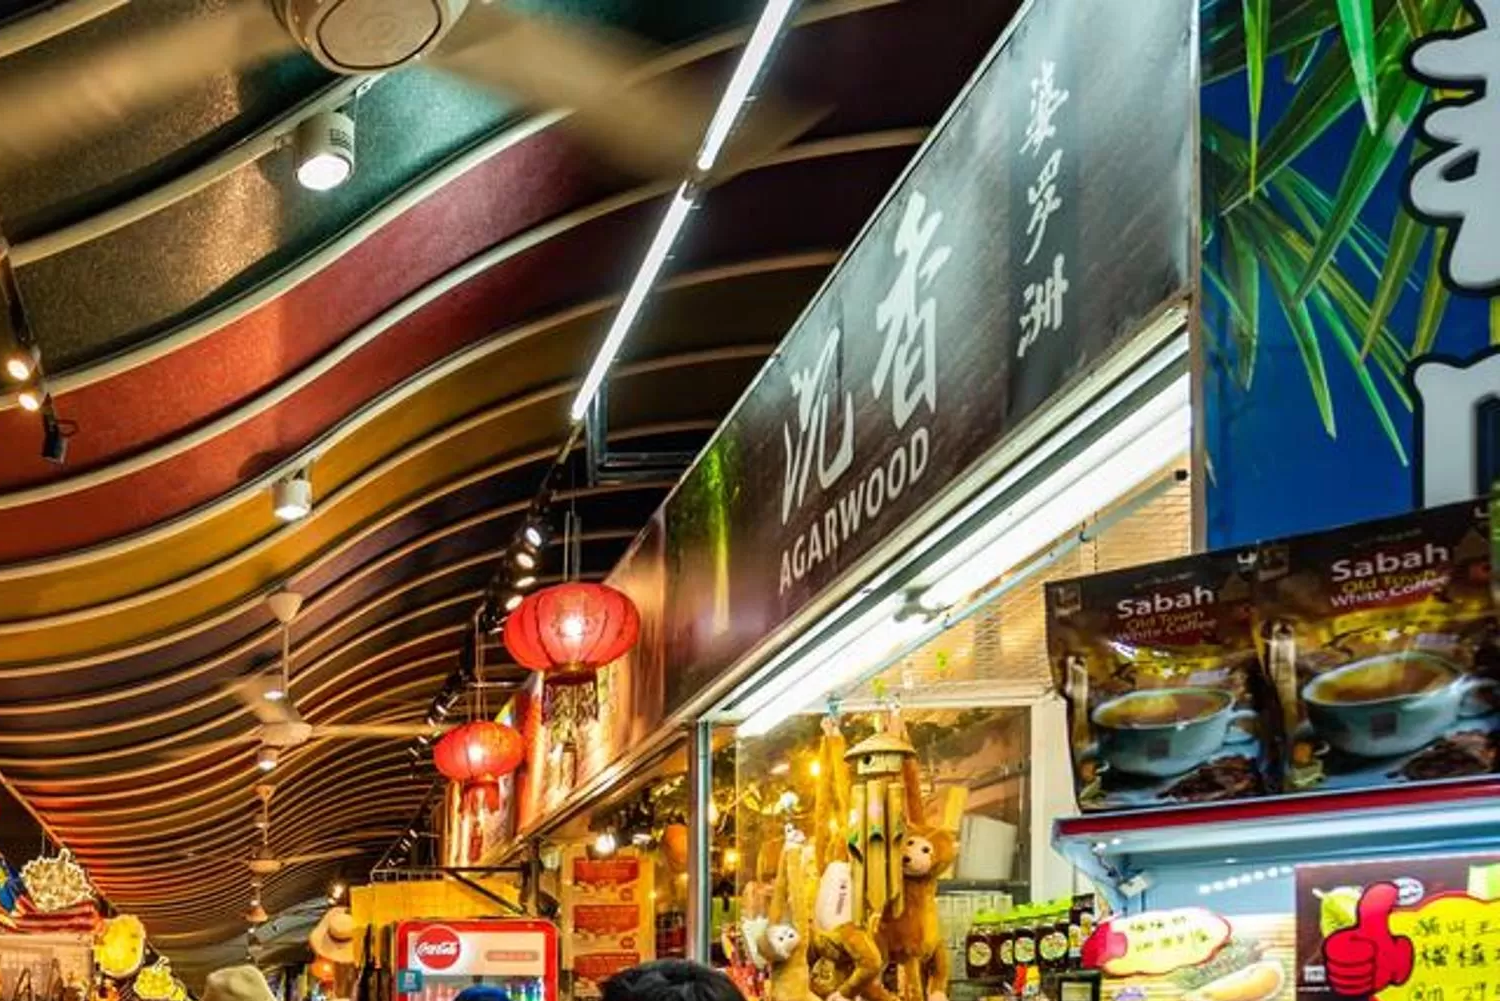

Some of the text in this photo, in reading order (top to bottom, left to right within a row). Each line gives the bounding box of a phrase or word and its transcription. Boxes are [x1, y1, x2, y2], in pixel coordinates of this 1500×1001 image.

[779, 427, 930, 595] AGARWOOD
[1331, 543, 1449, 582] Sabah
[1116, 585, 1214, 619] Sabah
[1330, 589, 1386, 608] White
